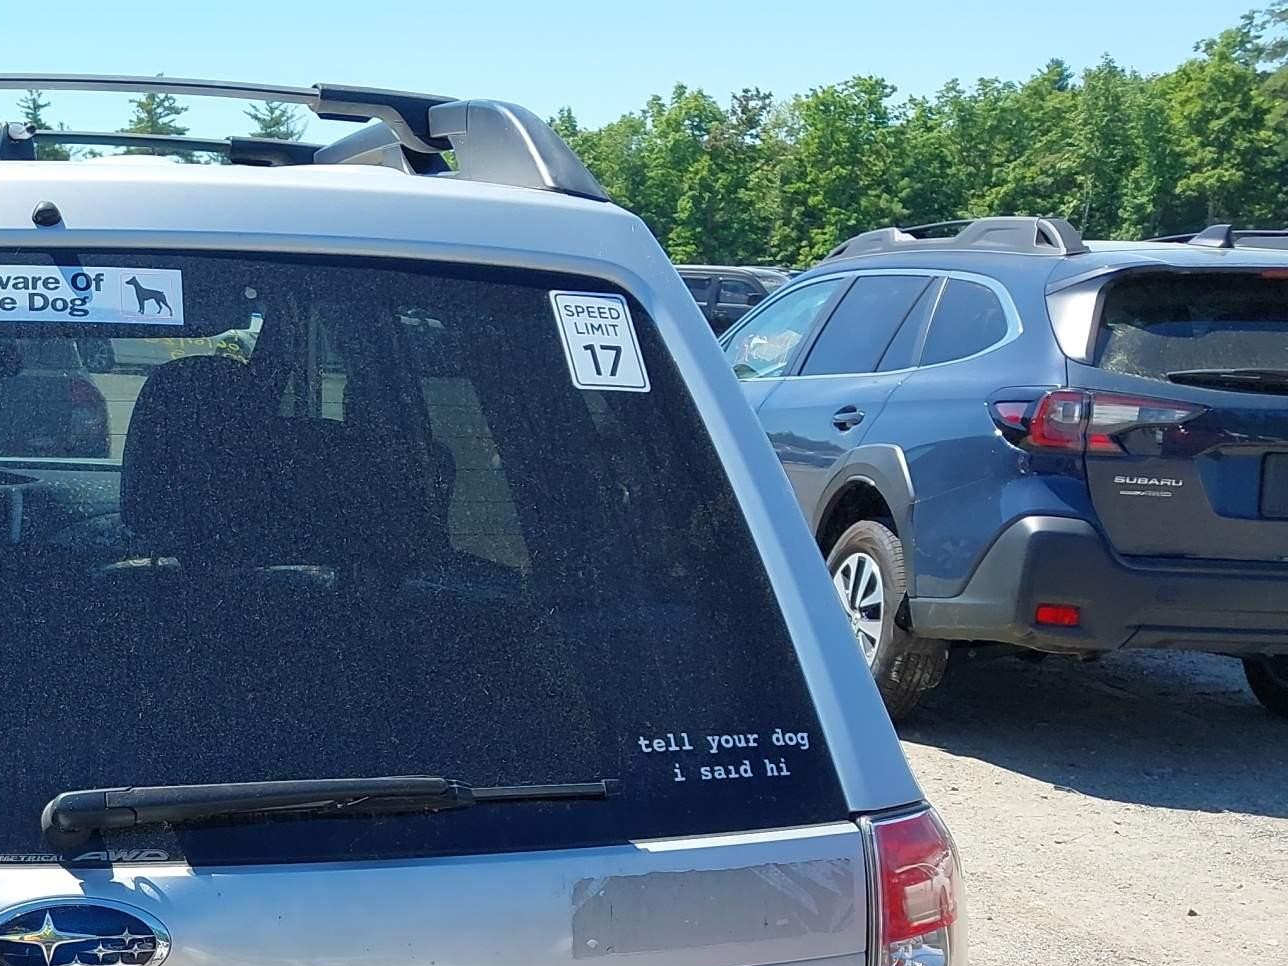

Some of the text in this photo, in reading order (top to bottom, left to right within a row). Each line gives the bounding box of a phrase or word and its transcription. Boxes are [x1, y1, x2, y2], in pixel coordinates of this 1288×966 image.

[70, 271, 105, 292] Of
[28, 292, 90, 317] Dog
[563, 304, 621, 320] SPEED
[573, 322, 619, 337] LIMIT
[582, 343, 623, 377] 17
[1113, 475, 1183, 487] SUBARU
[638, 728, 810, 754] tell your dog
[673, 758, 792, 782] i said hi
[72, 848, 170, 862] AWD
